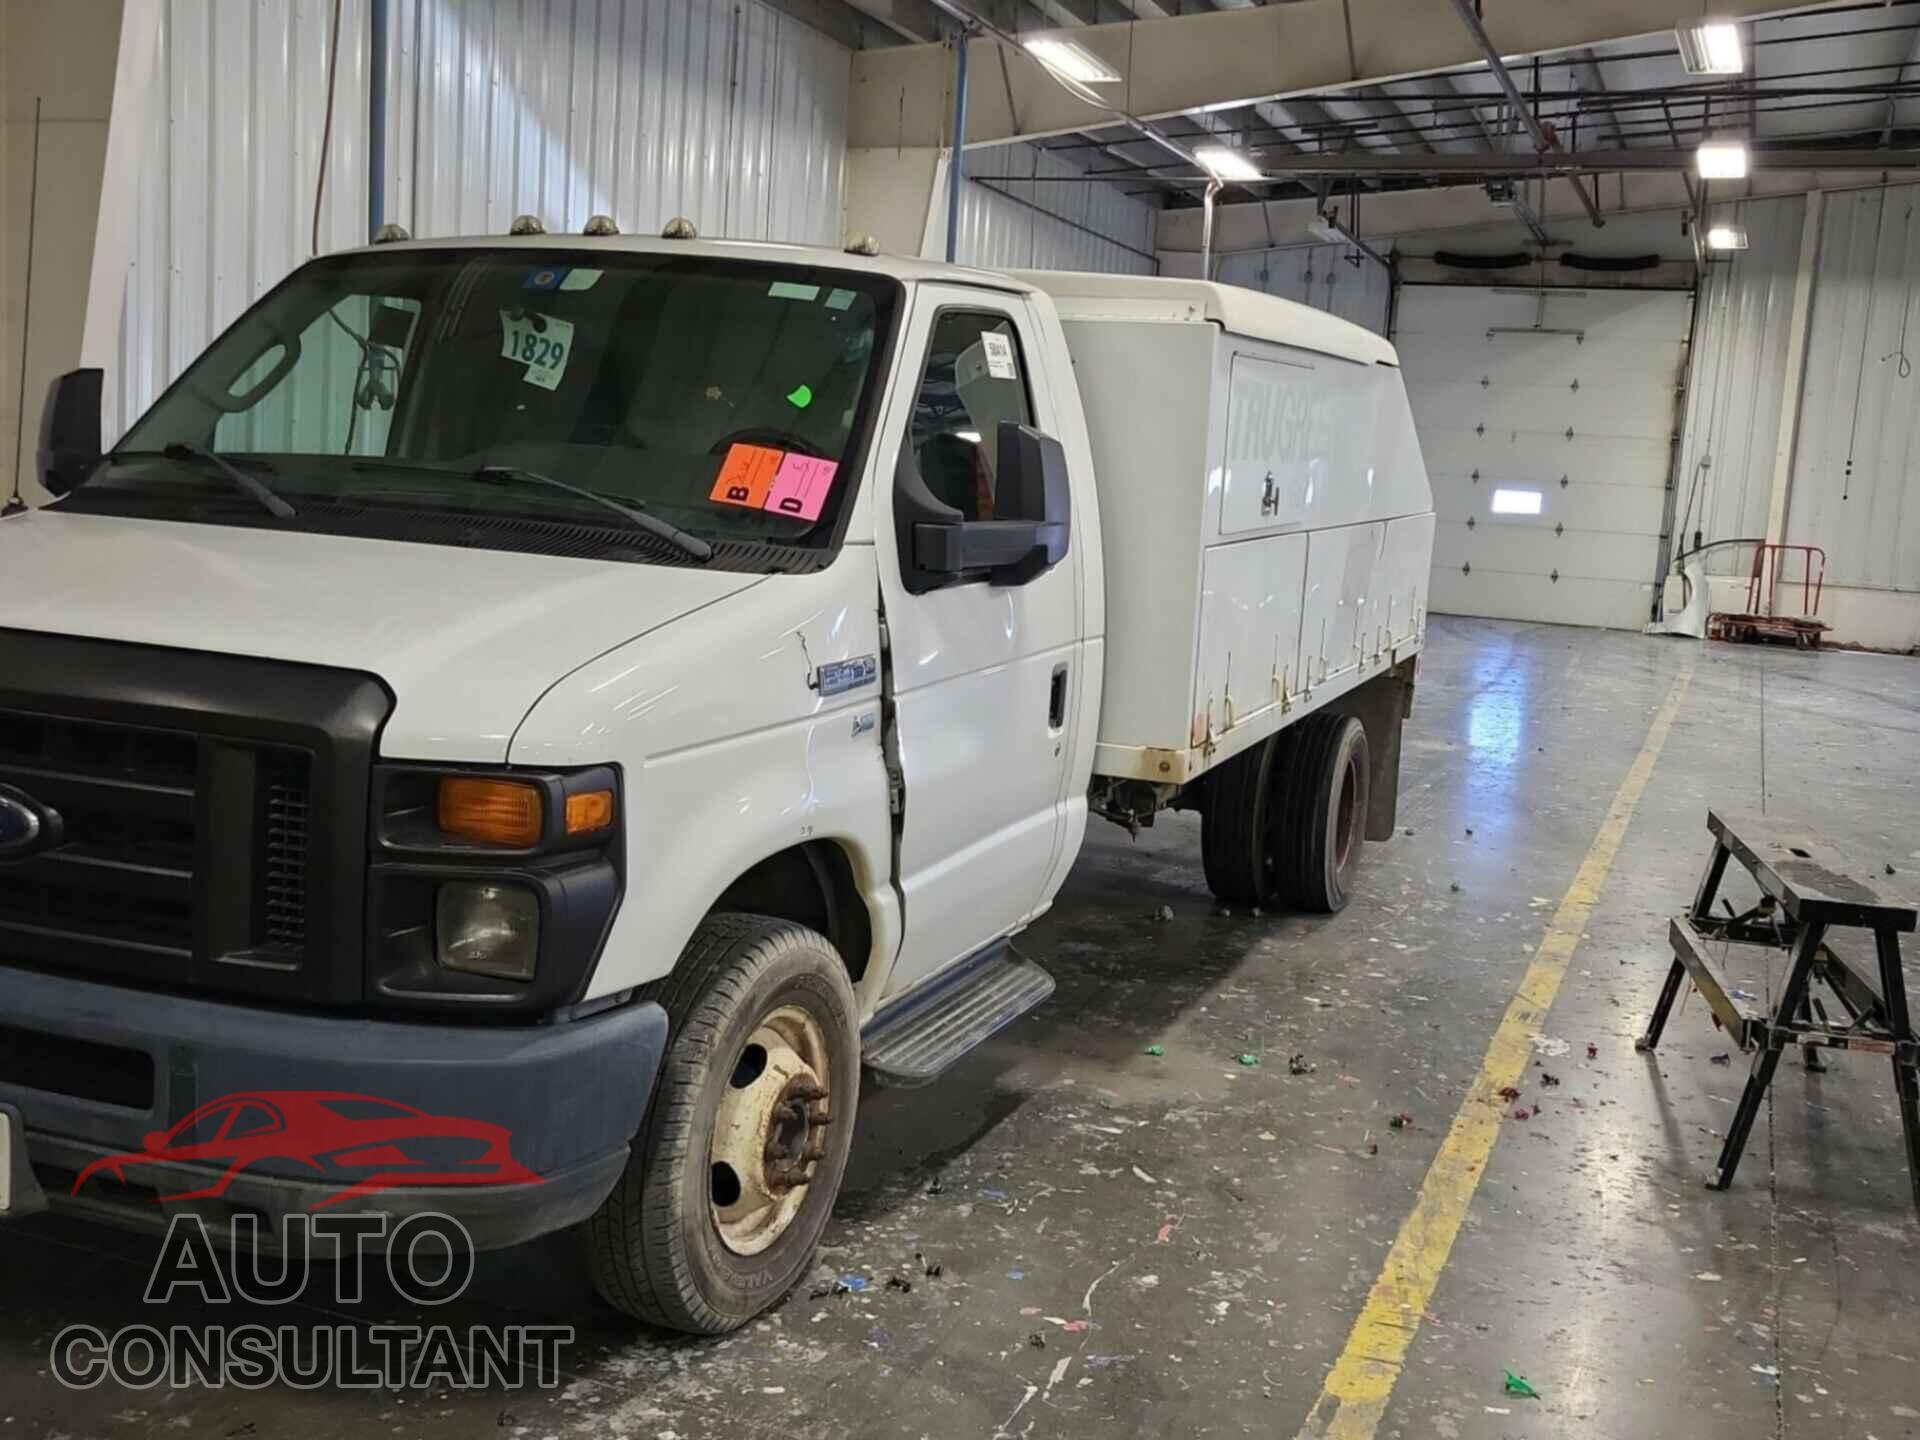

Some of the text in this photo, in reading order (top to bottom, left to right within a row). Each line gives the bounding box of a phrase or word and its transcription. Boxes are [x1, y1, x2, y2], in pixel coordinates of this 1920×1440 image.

[511, 330, 564, 370] 1829
[726, 486, 749, 502] B
[779, 497, 803, 514] D
